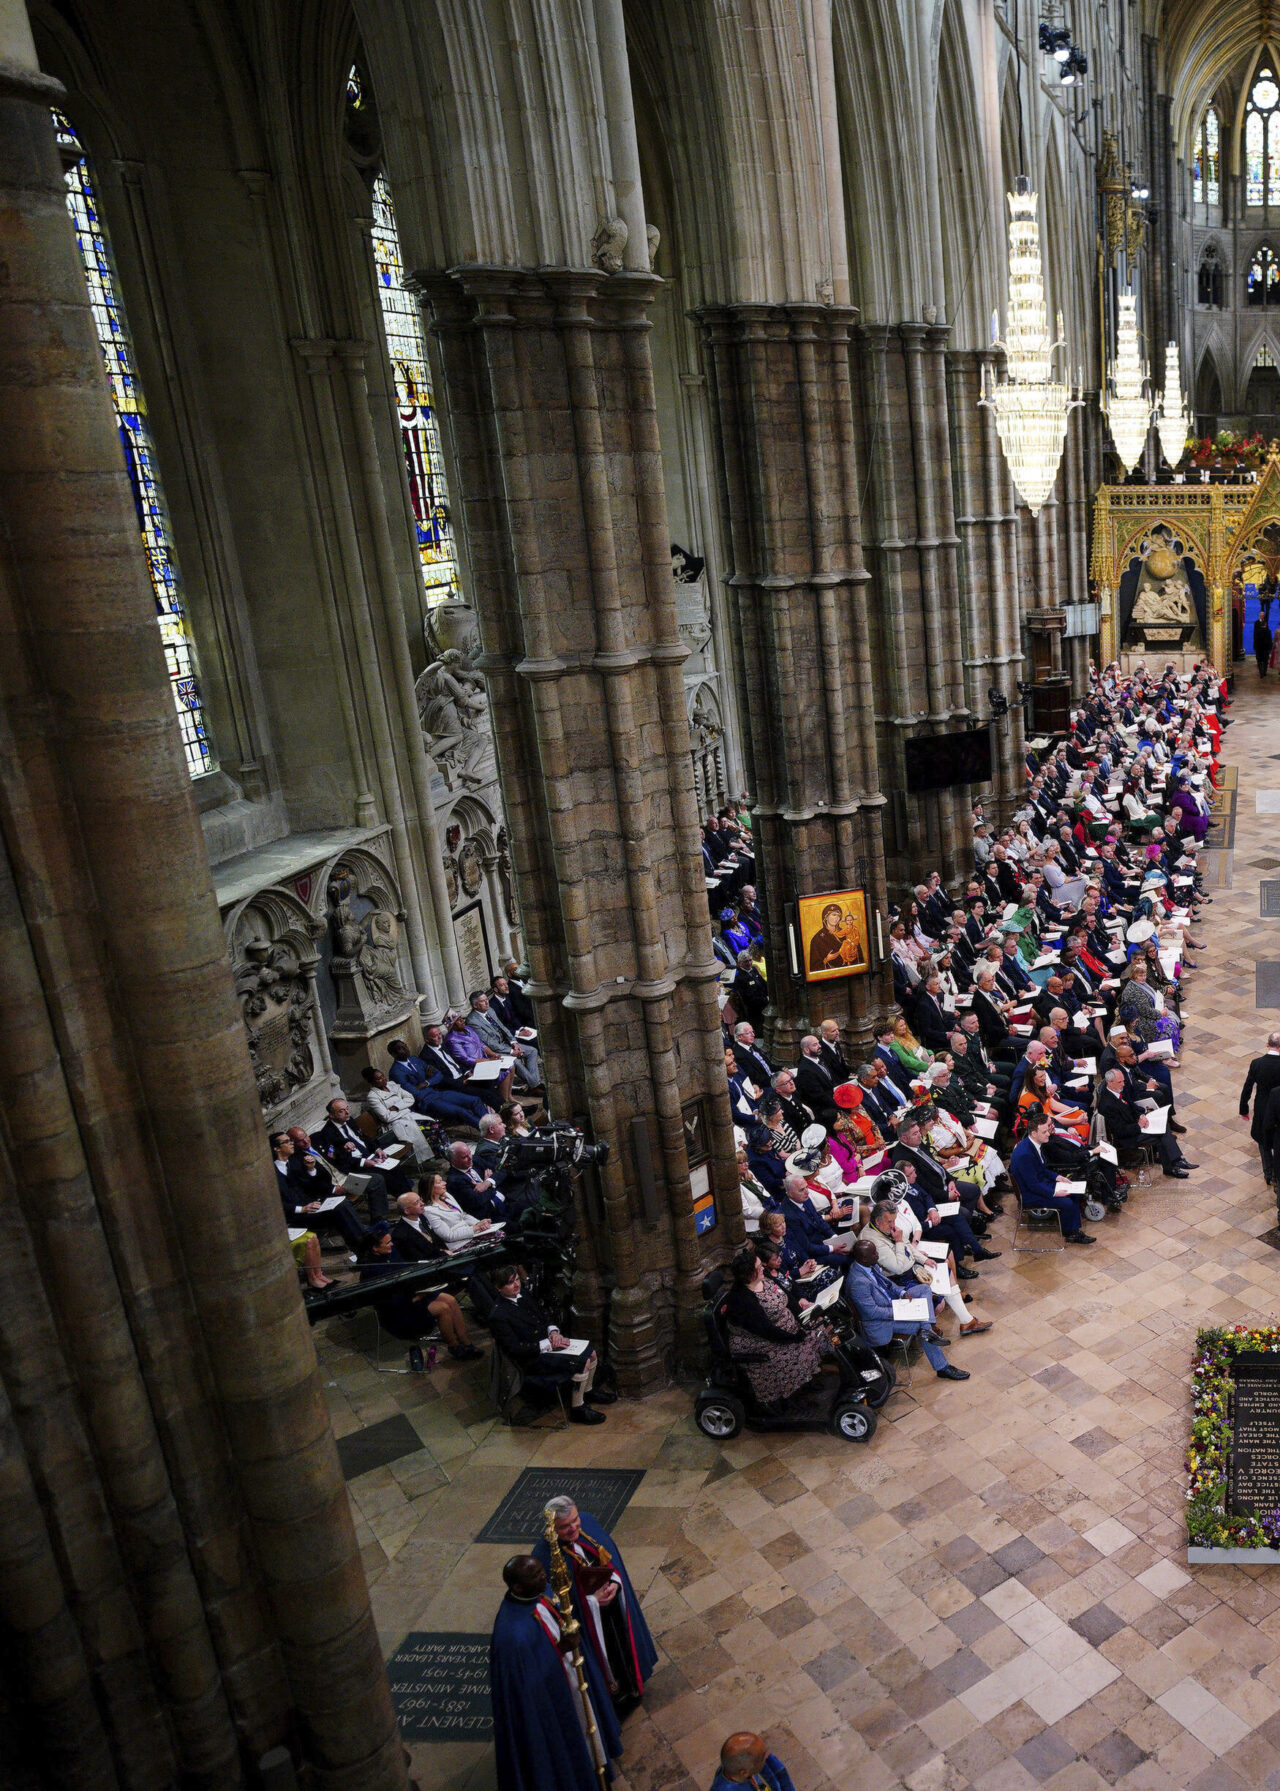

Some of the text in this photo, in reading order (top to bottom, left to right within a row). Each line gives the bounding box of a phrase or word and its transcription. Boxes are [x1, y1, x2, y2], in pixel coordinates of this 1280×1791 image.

[448, 1645, 490, 1653] LABOUR
[395, 1654, 433, 1663] LEADER
[434, 1655, 467, 1664] YEARS
[421, 1667, 488, 1680] 1945-1951
[390, 1682, 492, 1695] RIME MINISTER
[416, 1716, 494, 1729] CLEMENT
